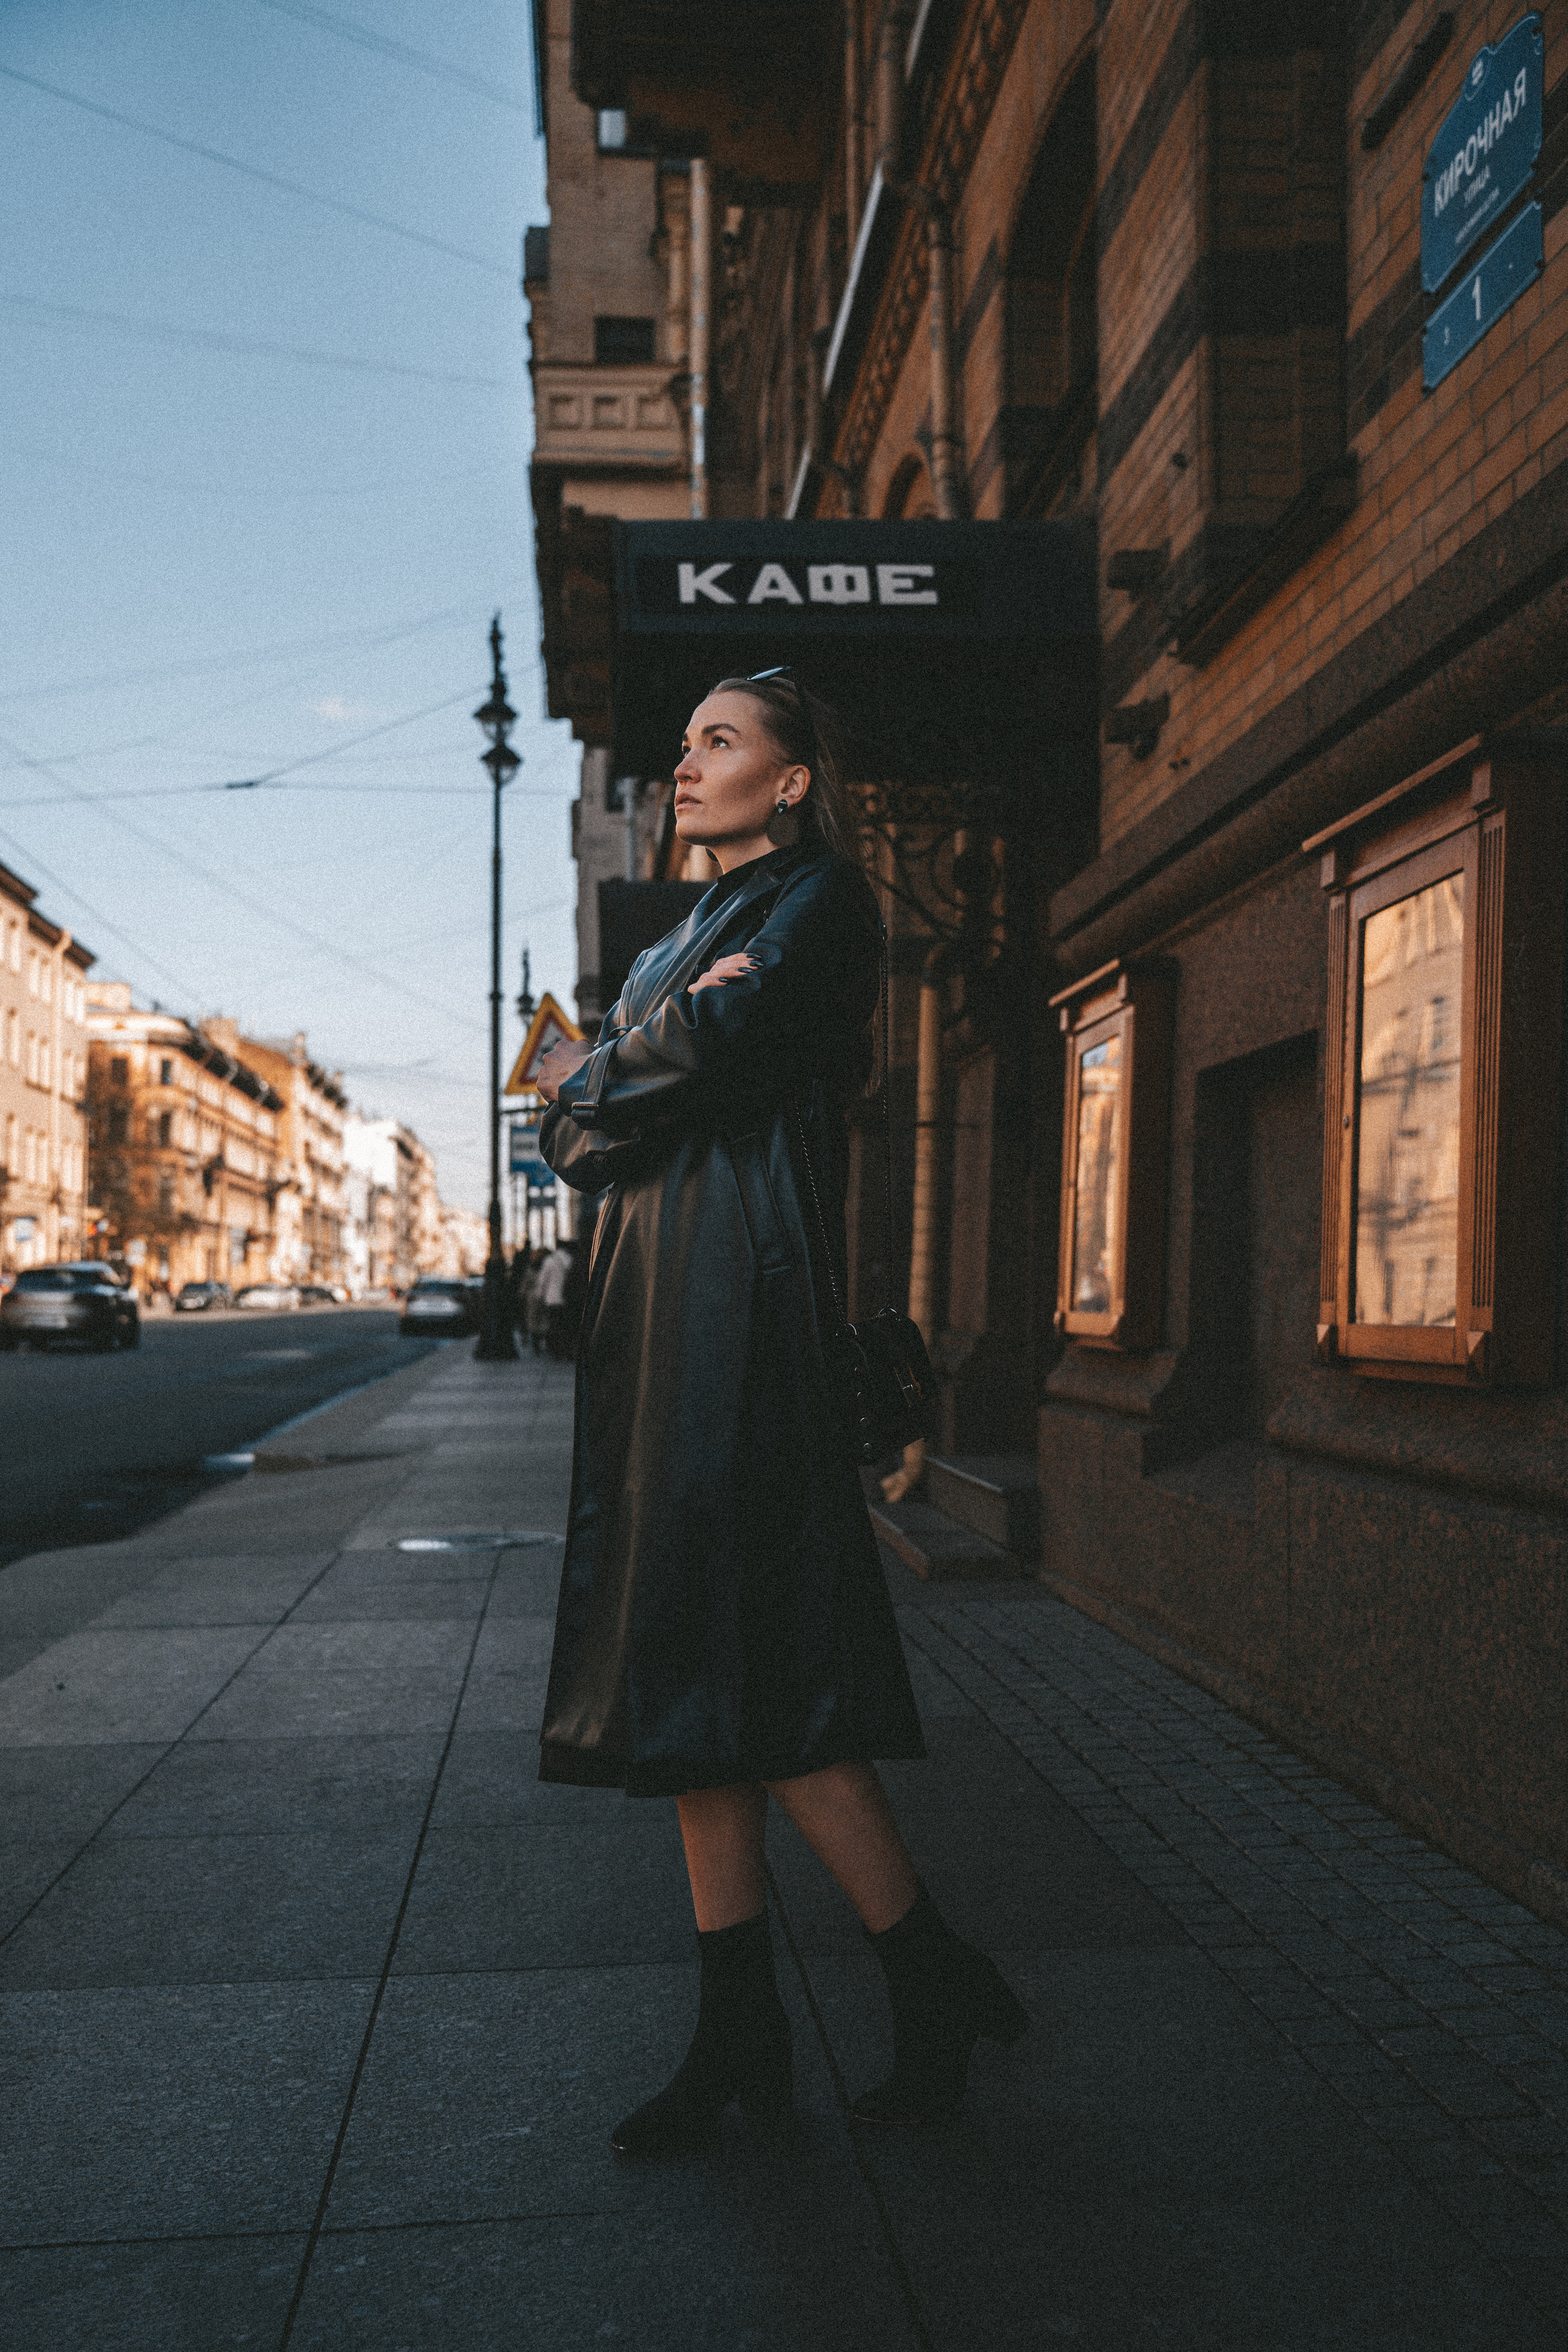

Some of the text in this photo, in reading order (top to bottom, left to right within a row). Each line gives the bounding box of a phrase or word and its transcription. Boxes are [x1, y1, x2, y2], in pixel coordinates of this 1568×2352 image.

[1434, 67, 1526, 217] КИРОЧНАЯ
[1471, 276, 1482, 321] 1
[677, 562, 938, 606] КАФЕ
